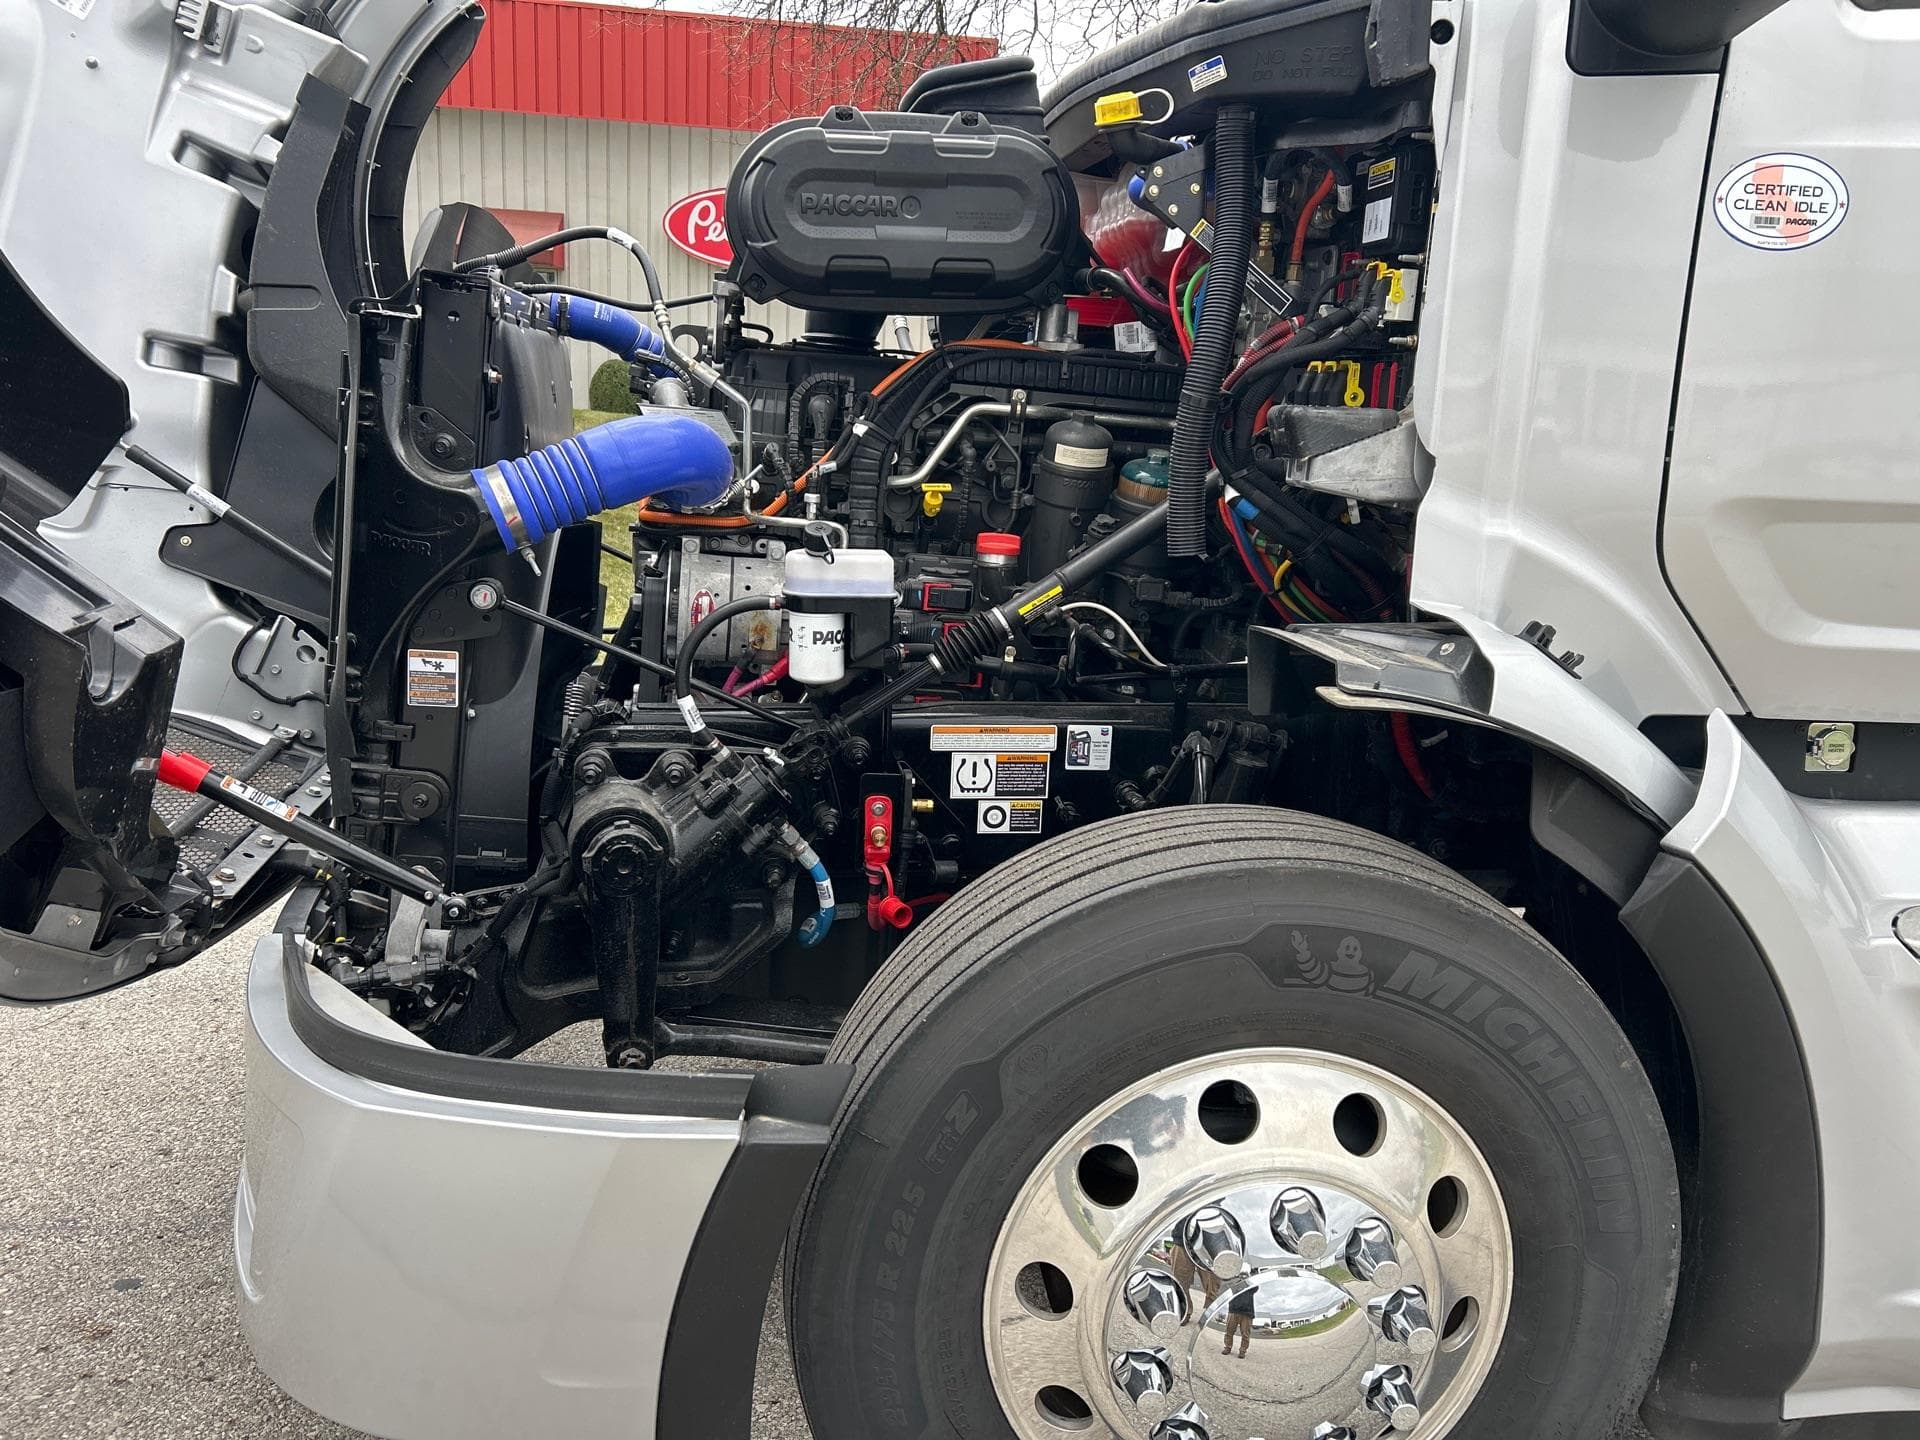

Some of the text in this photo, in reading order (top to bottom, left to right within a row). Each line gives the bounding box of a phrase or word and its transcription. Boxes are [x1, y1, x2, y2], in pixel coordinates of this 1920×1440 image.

[1743, 183, 1823, 197] CERTIFIED
[800, 192, 898, 217] PACCAR
[1733, 199, 1829, 213] CLEAN IDLE
[1785, 217, 1818, 226] PACCAR
[1383, 950, 1638, 1234] MICHELIN
